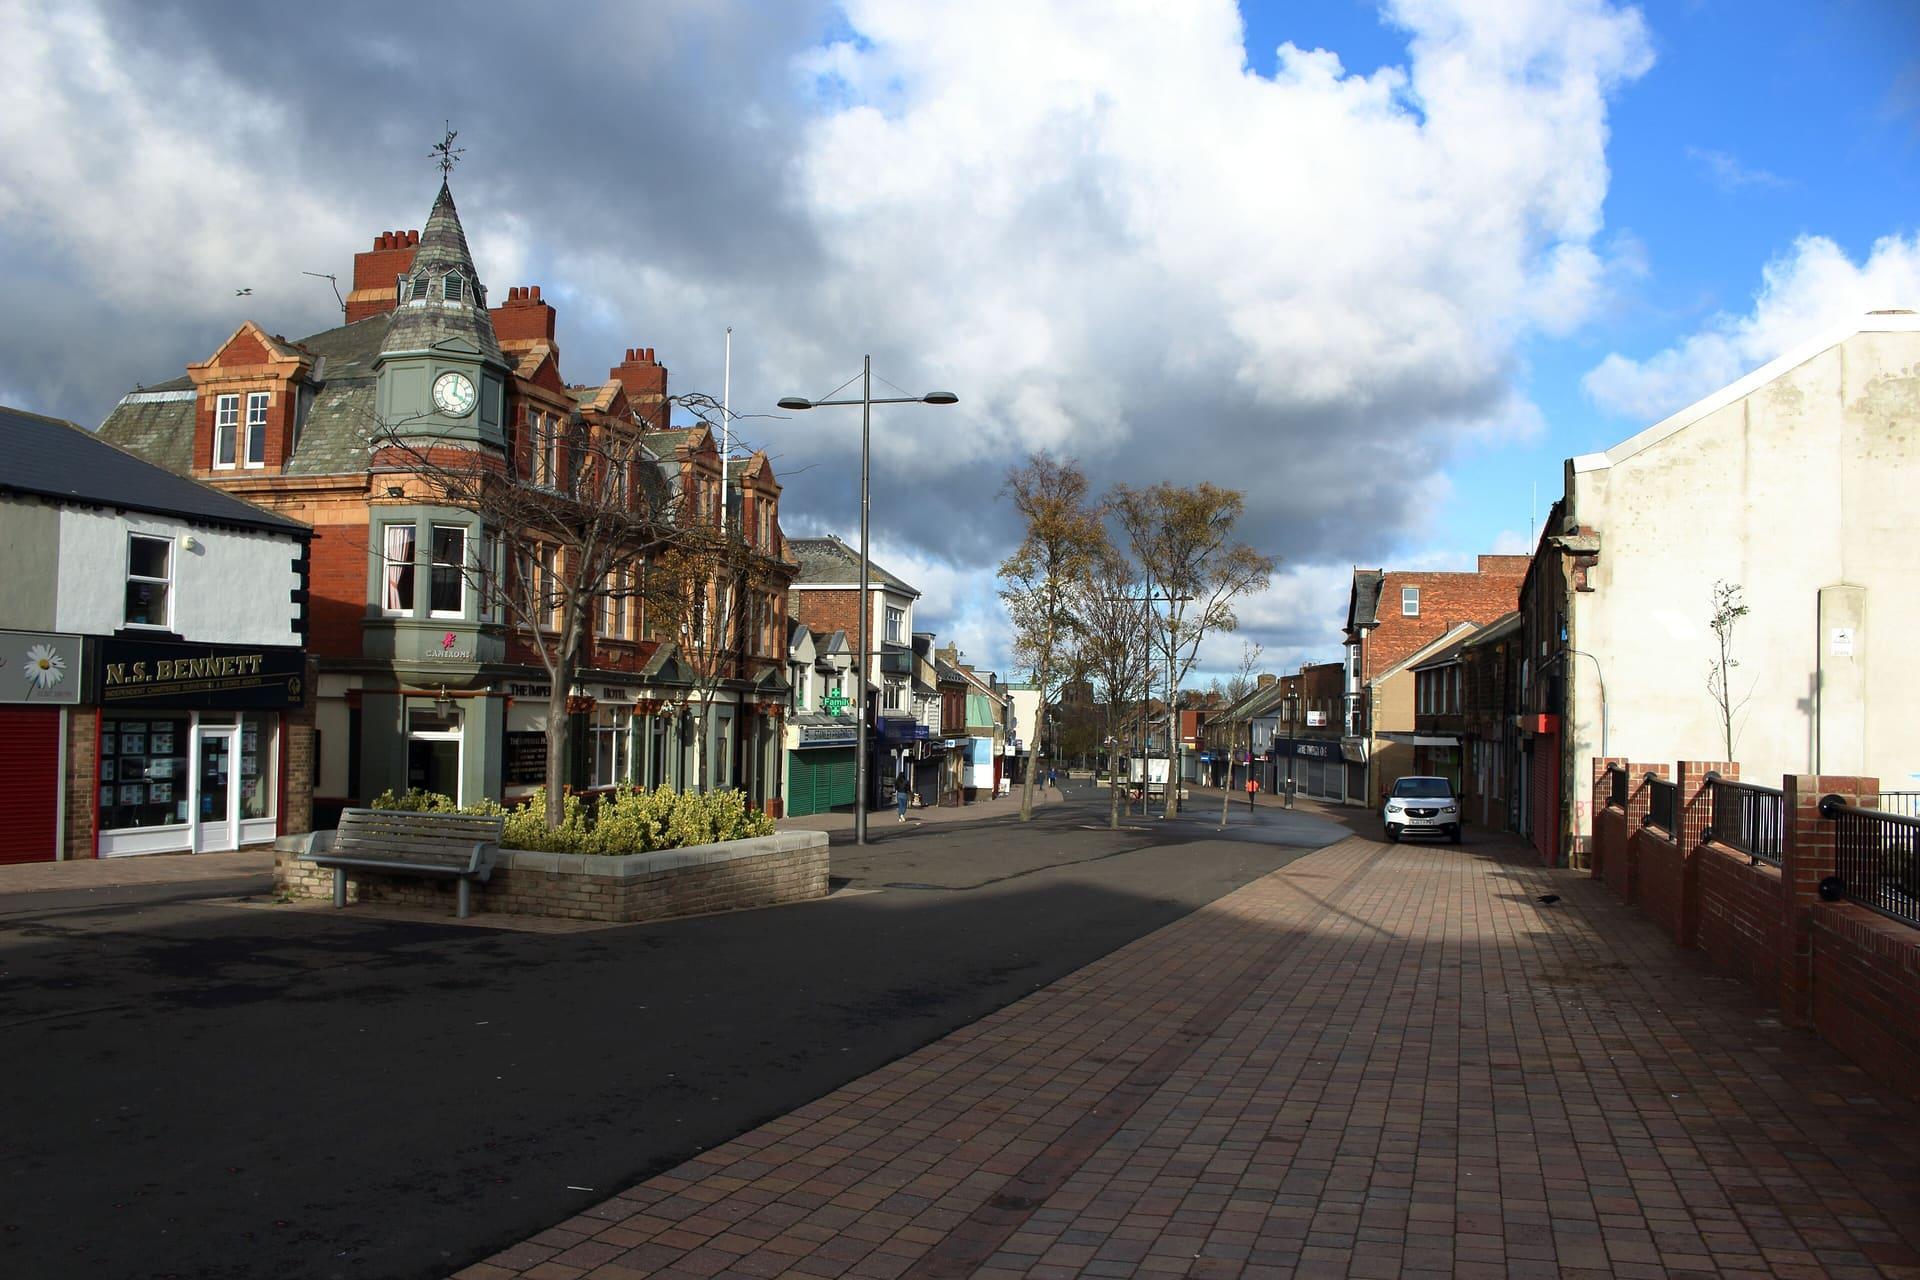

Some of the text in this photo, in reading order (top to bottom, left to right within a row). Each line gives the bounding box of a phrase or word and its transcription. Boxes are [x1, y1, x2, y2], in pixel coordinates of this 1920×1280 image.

[426, 649, 470, 658] CAMERONS
[106, 655, 263, 685] N.S. BENNETT
[511, 684, 528, 696] THE
[603, 687, 627, 700] HOTEL
